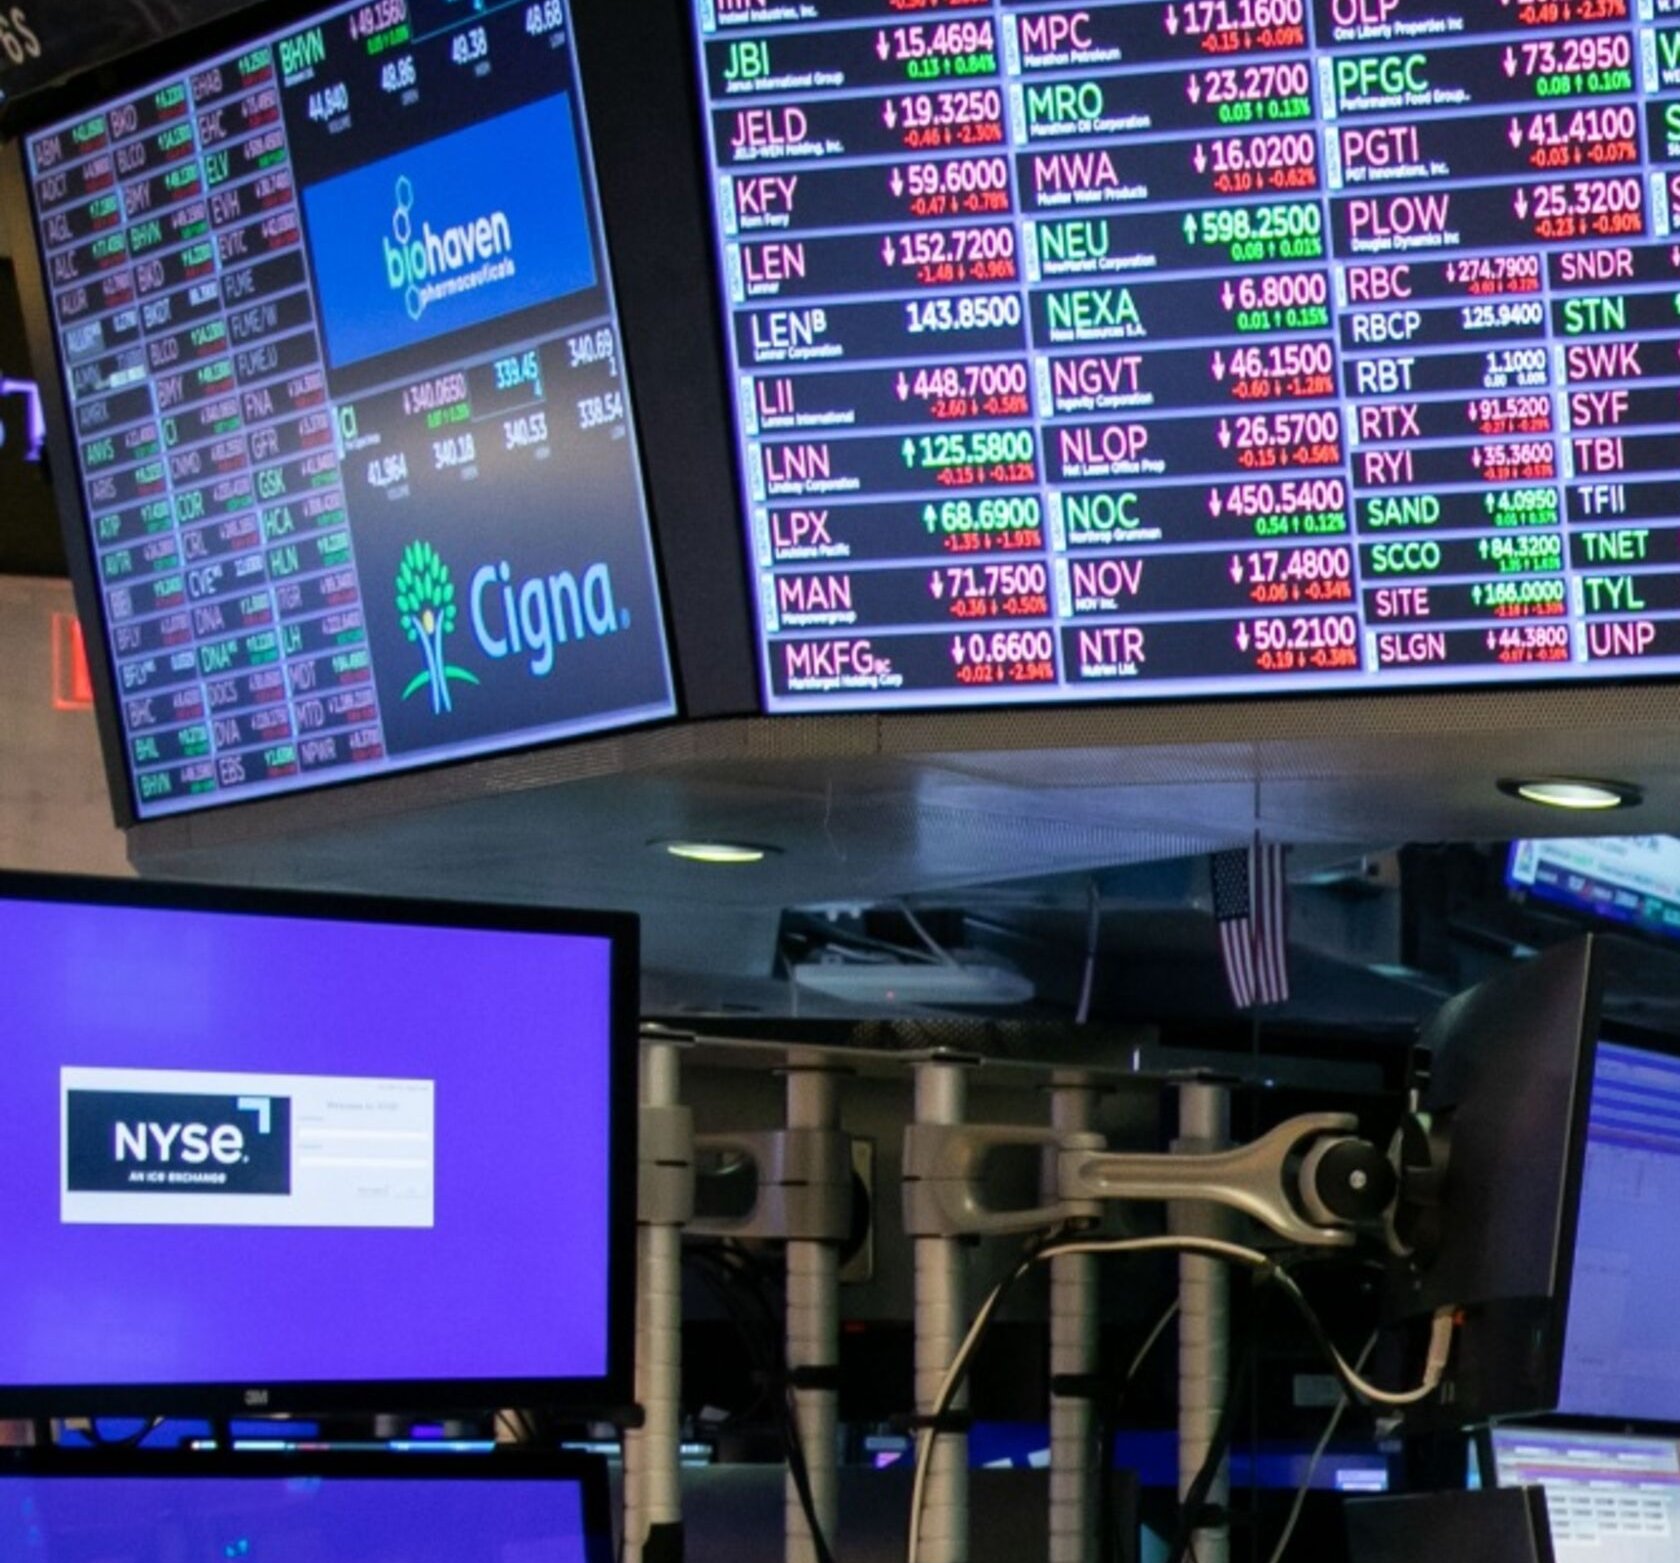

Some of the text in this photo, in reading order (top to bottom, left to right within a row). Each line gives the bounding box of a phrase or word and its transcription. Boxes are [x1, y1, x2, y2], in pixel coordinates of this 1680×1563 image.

[725, 21, 993, 80] JBI 15.4694
[1023, 13, 1091, 52] MPC
[1029, 63, 1308, 120] MRO 23.2700
[1339, 36, 1630, 95] PFGC 73.2950
[732, 89, 1000, 145] JELD 19.3250
[737, 159, 1006, 213] KFY 59.6000
[1350, 179, 1640, 236] PLOW 25.3200
[383, 210, 512, 289] biohaven
[745, 227, 1013, 280] LEN 152.7200
[907, 296, 1019, 331] 143.8500
[1048, 274, 1325, 326] NEXA 6.8000
[773, 498, 1040, 545] LPX 68.6900
[1368, 497, 1439, 526] SAND
[780, 565, 1045, 610] MAN 71.7500
[1074, 549, 1350, 596] NOV 17.4800
[1591, 623, 1654, 655] UNP
[244, 1390, 268, 1405] 3M
